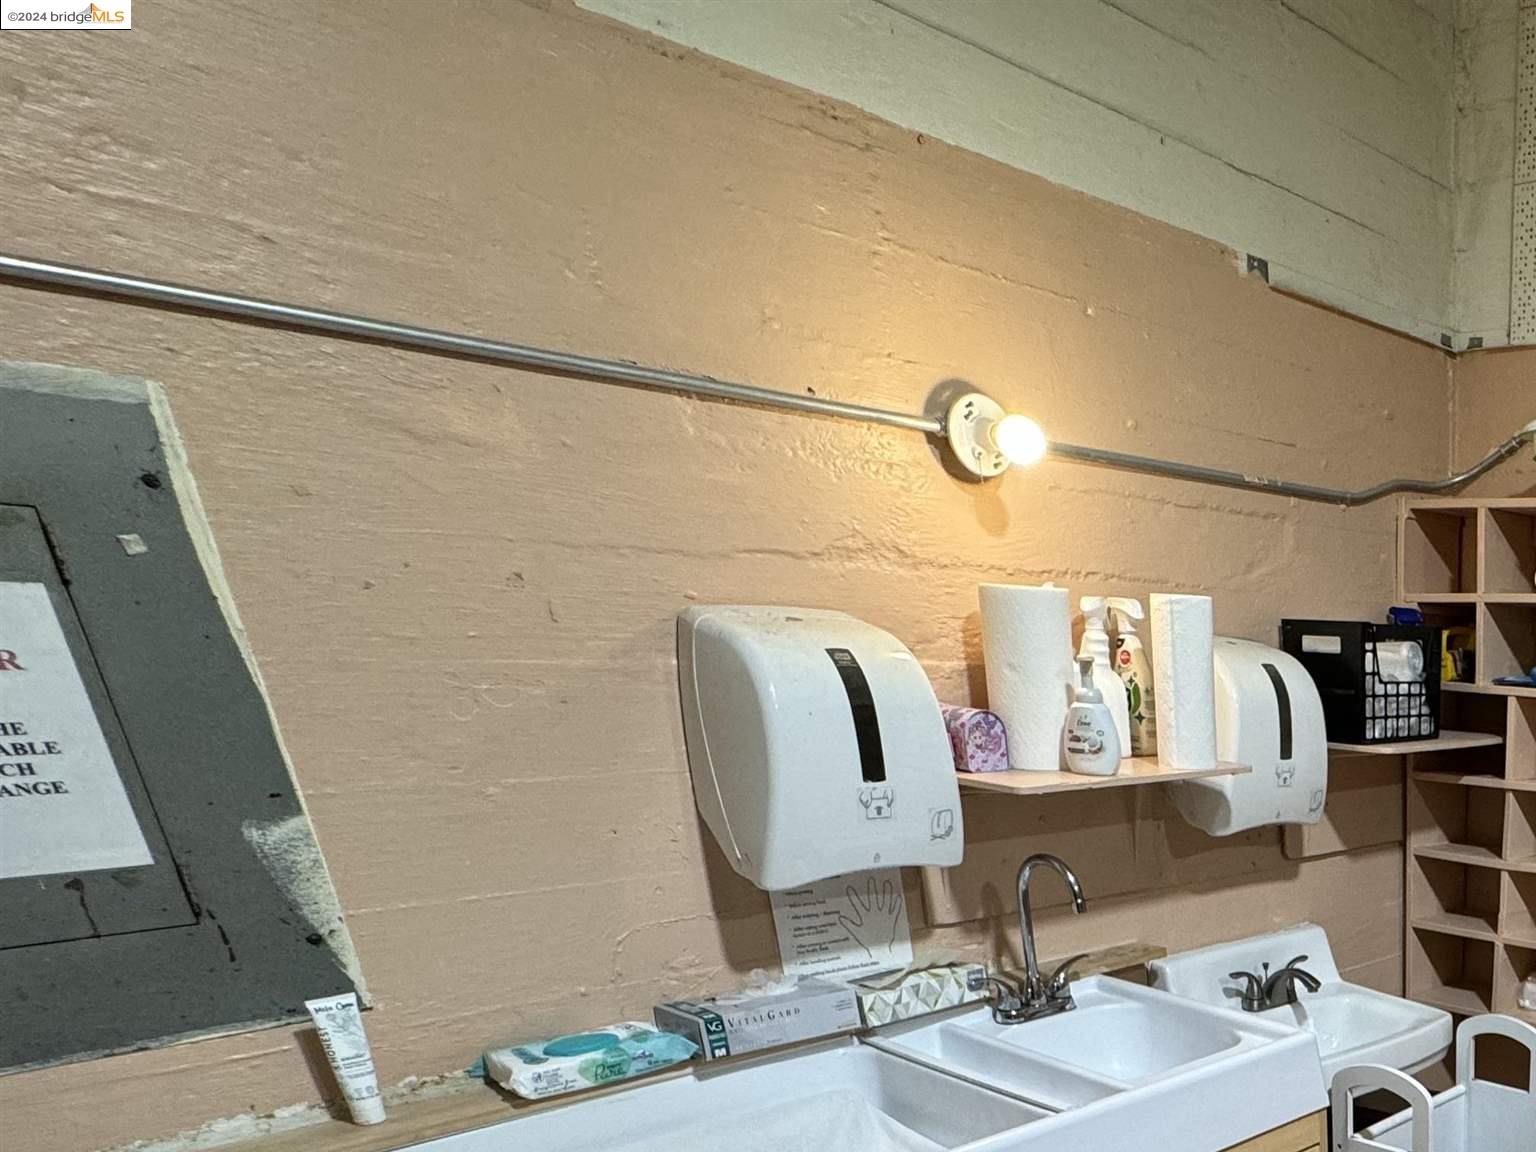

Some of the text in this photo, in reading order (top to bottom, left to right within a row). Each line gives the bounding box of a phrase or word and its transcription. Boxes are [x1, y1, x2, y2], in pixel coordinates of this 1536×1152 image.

[0, 741, 62, 756] ABLE
[0, 762, 37, 777] CH
[0, 780, 69, 798] ANGE
[706, 1021, 723, 1032] VG
[715, 1046, 727, 1057] M
